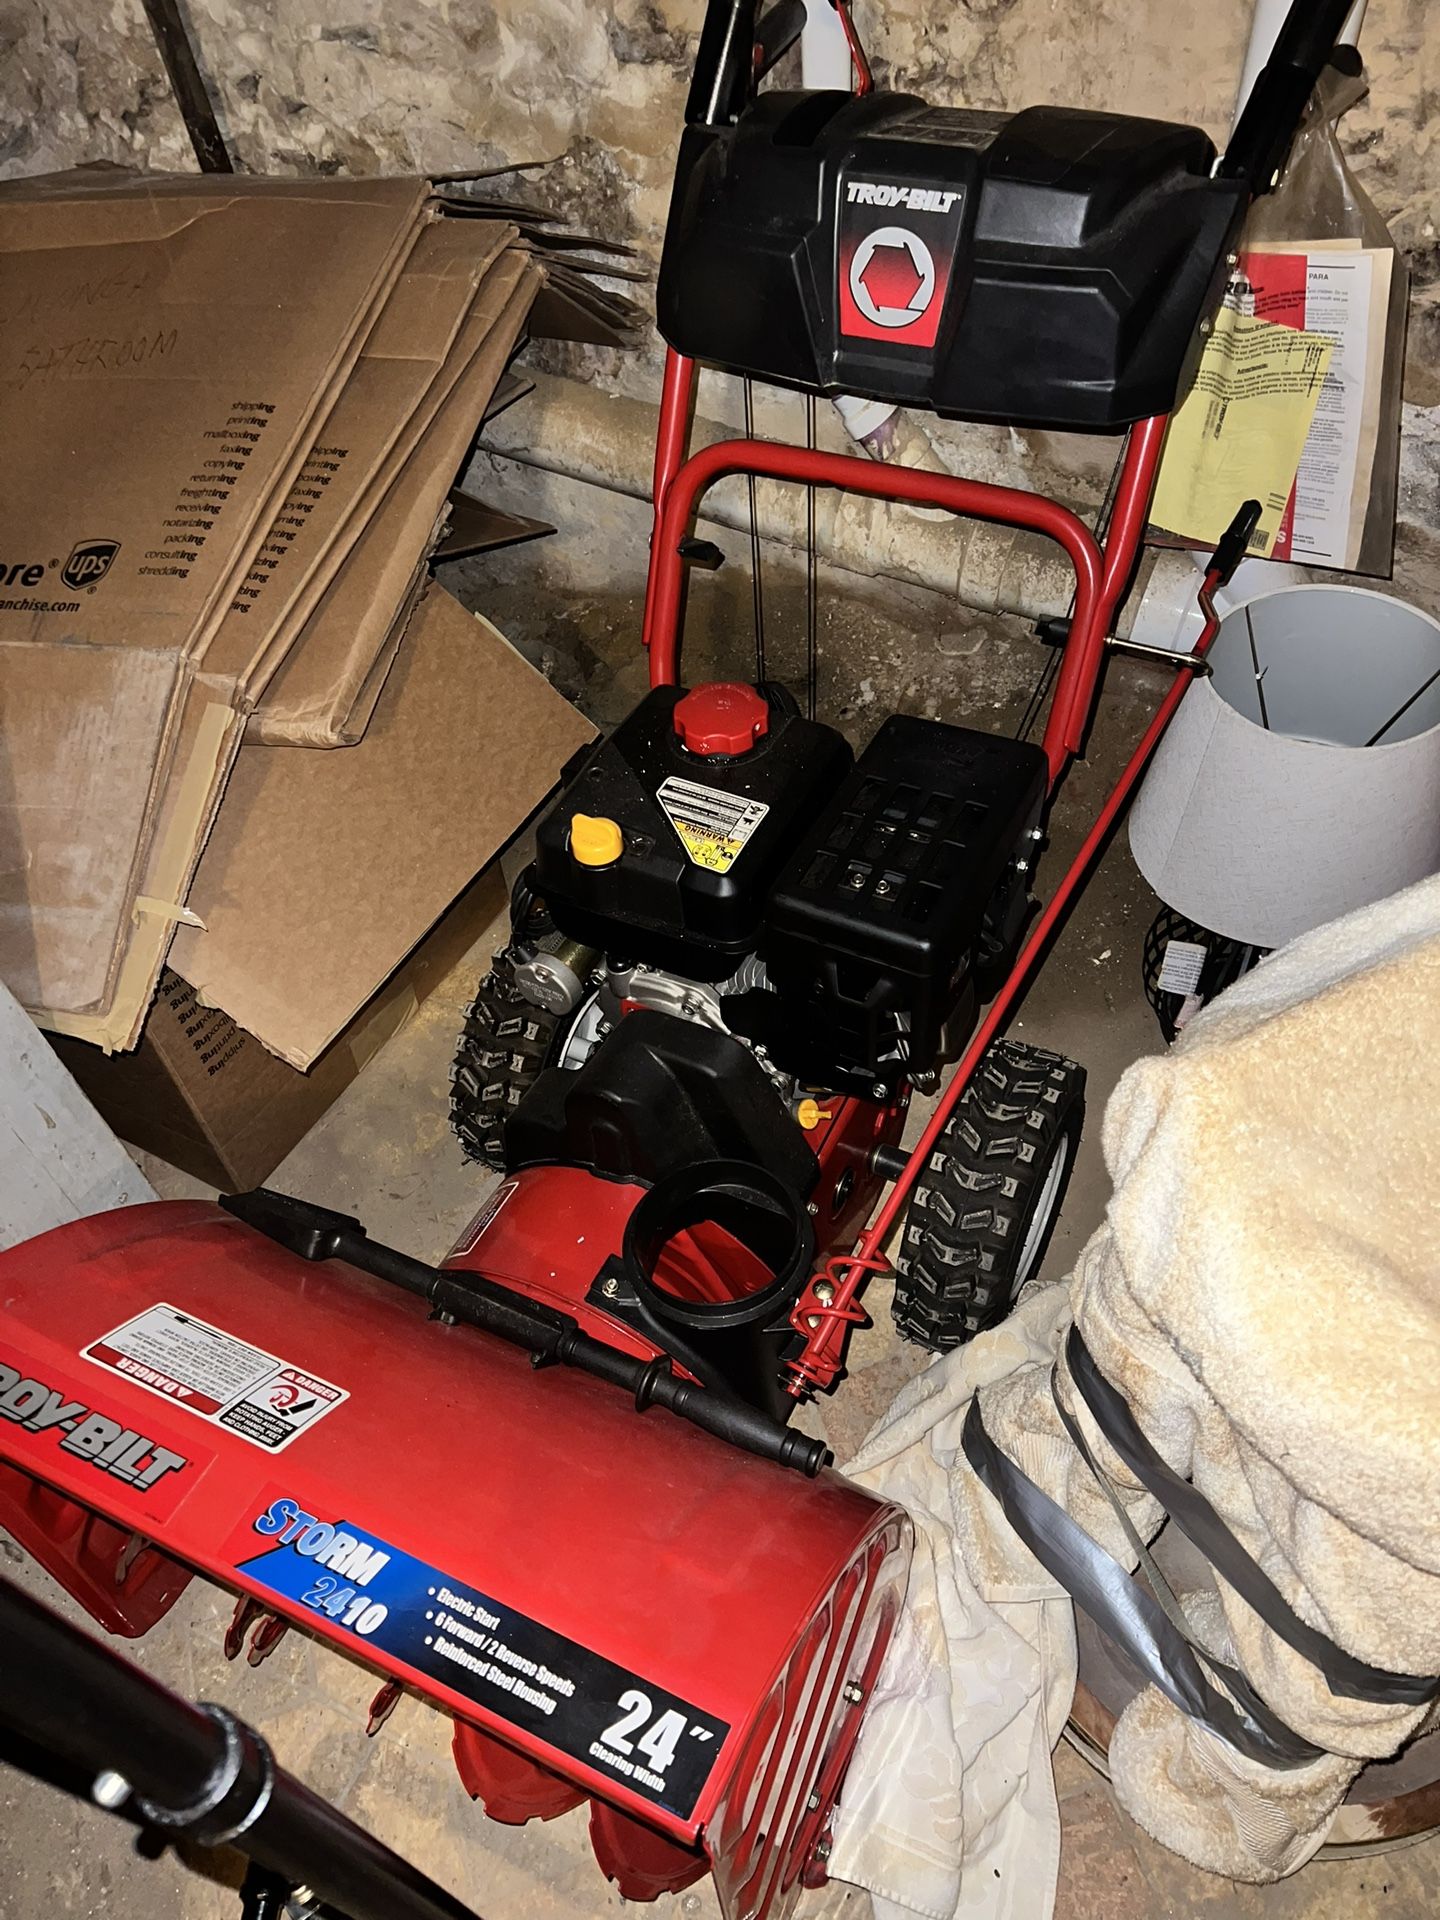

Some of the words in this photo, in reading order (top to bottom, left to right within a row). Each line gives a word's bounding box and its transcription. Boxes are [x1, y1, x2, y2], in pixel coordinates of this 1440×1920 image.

[847, 182, 957, 213] TROY-BILT
[231, 402, 276, 413] shipping
[226, 416, 268, 427] printing
[203, 430, 261, 442] mailboxing
[220, 444, 253, 456] faxing
[203, 459, 245, 470] copying
[190, 474, 237, 485] returning
[175, 503, 222, 514] receiving
[162, 519, 214, 530] notarizing
[164, 534, 206, 546] packing
[68, 555, 110, 580] ups
[137, 566, 190, 578] shredding
[685, 825, 725, 843] WARNING
[200, 1026, 236, 1064] printing
[207, 1037, 246, 1076] shipping
[116, 1357, 180, 1395] DANGER
[295, 1376, 338, 1400] DANGER
[252, 1498, 391, 1587] STORM
[300, 1576, 389, 1635] 2410
[436, 1587, 476, 1618] Electric
[473, 1606, 500, 1631] Start
[434, 1611, 446, 1627] 6
[443, 1615, 486, 1650] Forward
[487, 1640, 500, 1655] 2
[495, 1644, 538, 1677] Reverse
[535, 1664, 575, 1697] Speeds
[433, 1636, 491, 1677] Reinforced
[486, 1664, 516, 1691] Steel
[512, 1678, 557, 1715] Housing
[589, 1741, 634, 1776] Clearing
[632, 1765, 666, 1793] Width
